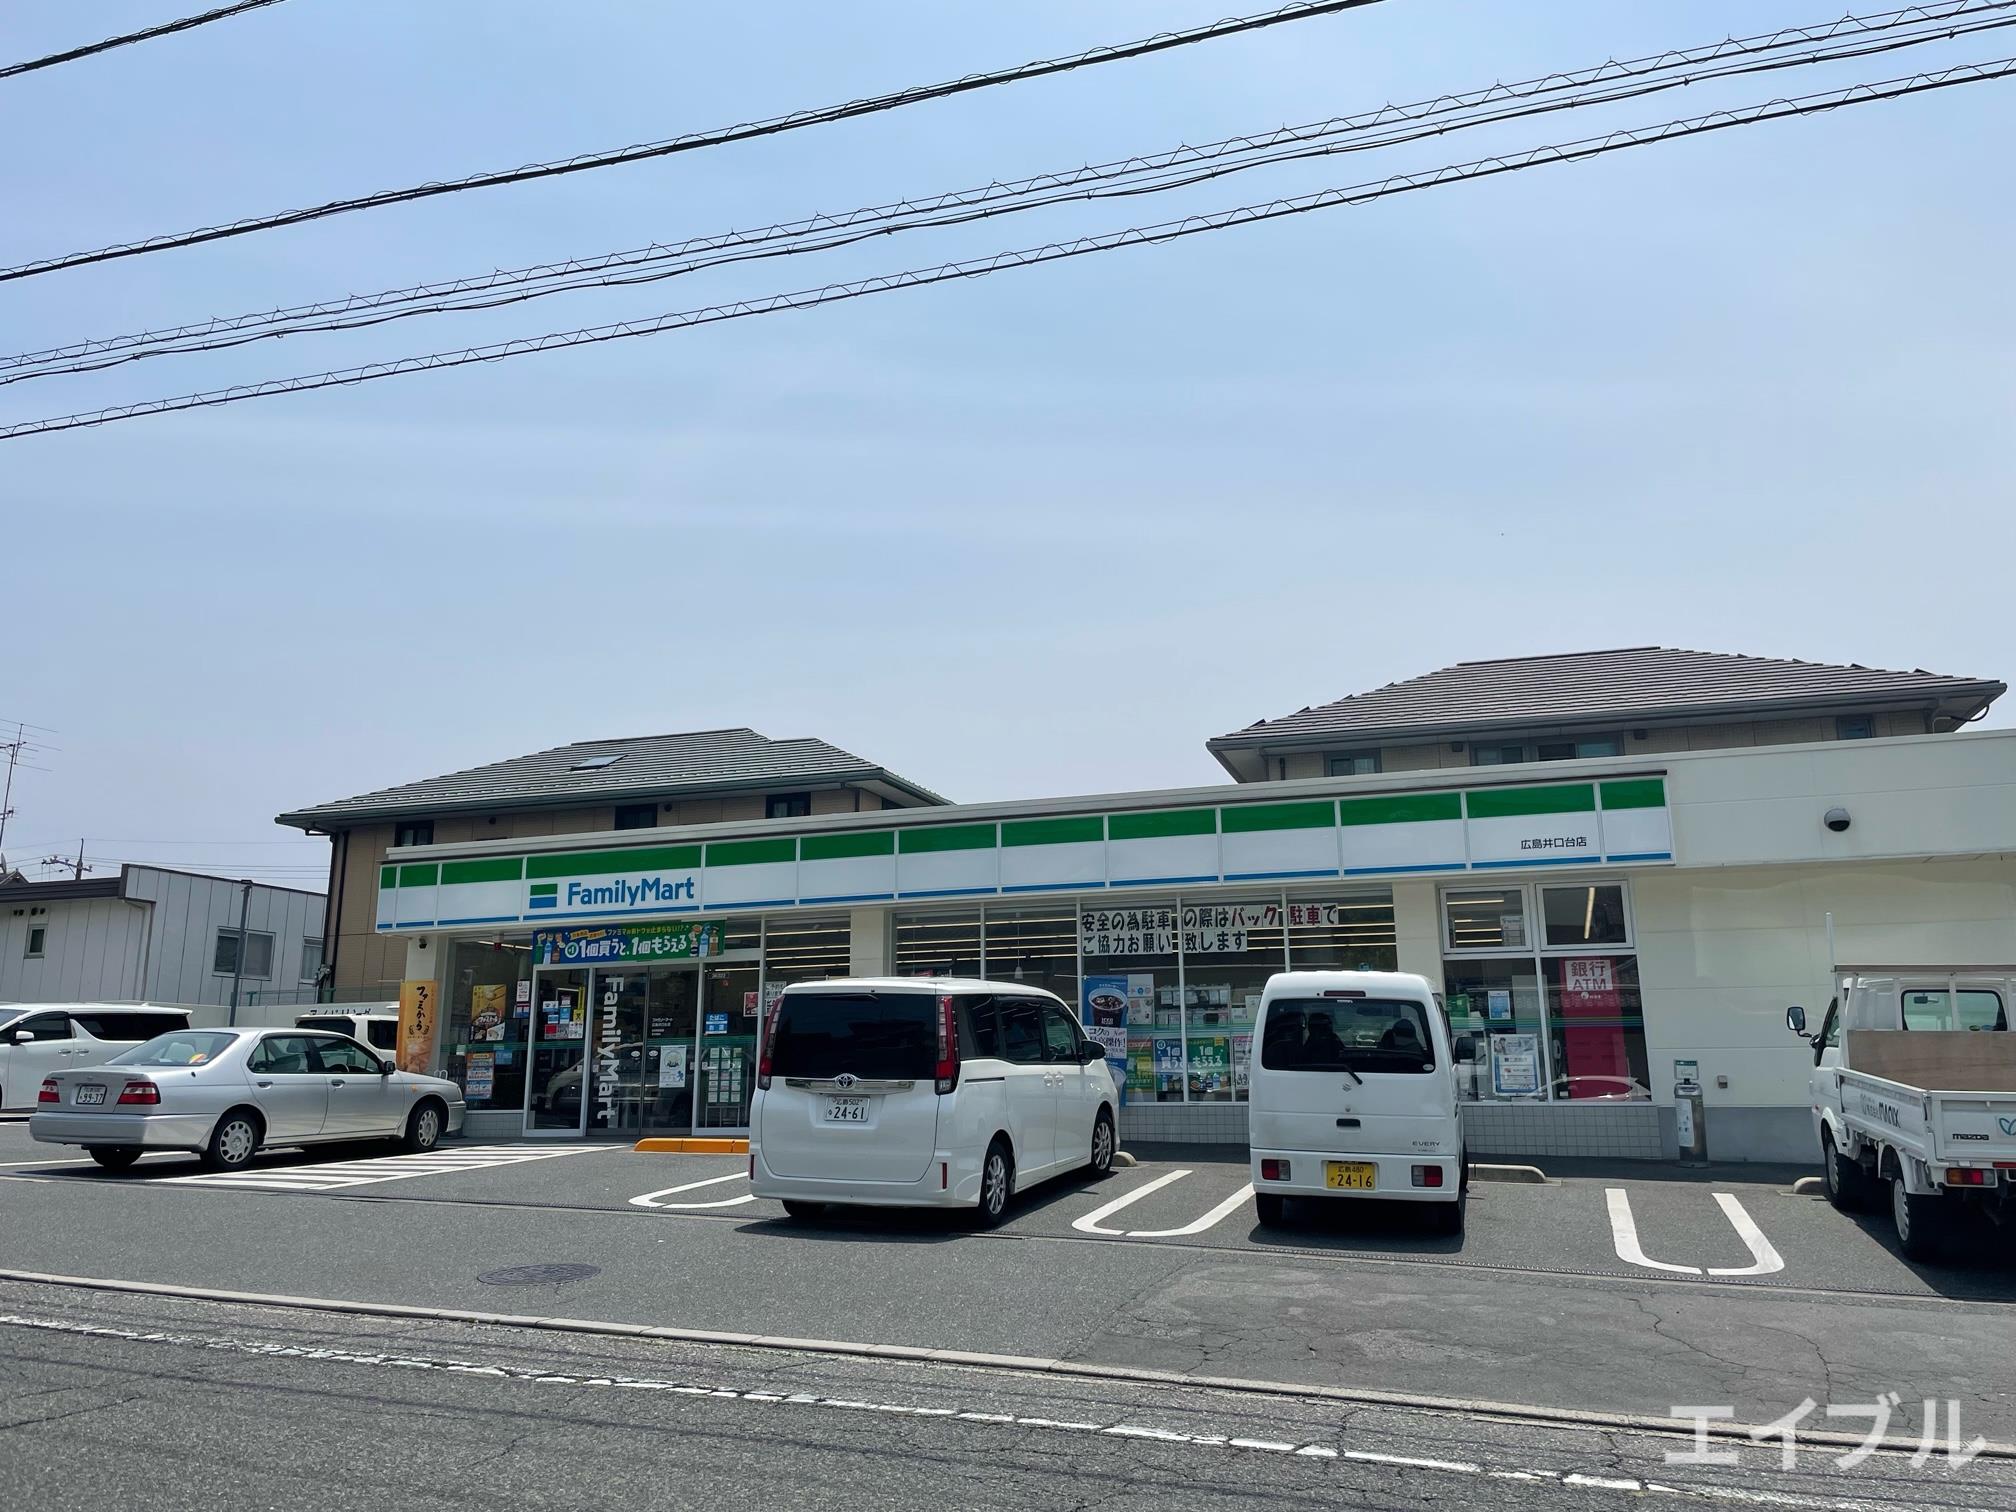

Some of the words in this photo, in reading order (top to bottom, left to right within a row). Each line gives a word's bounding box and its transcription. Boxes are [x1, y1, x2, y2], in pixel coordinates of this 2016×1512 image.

[1521, 836, 1587, 850] 広島井口台店
[567, 876, 695, 906] FamilyMart
[1082, 930, 1247, 955] ご協力お願い致します
[1571, 961, 1606, 977] 銀行
[1572, 978, 1607, 990] ATM
[416, 985, 429, 1031] ファミから
[597, 977, 625, 1120] FamilyMart
[833, 1106, 865, 1120] 24-61
[1337, 1173, 1373, 1188] 24-16
